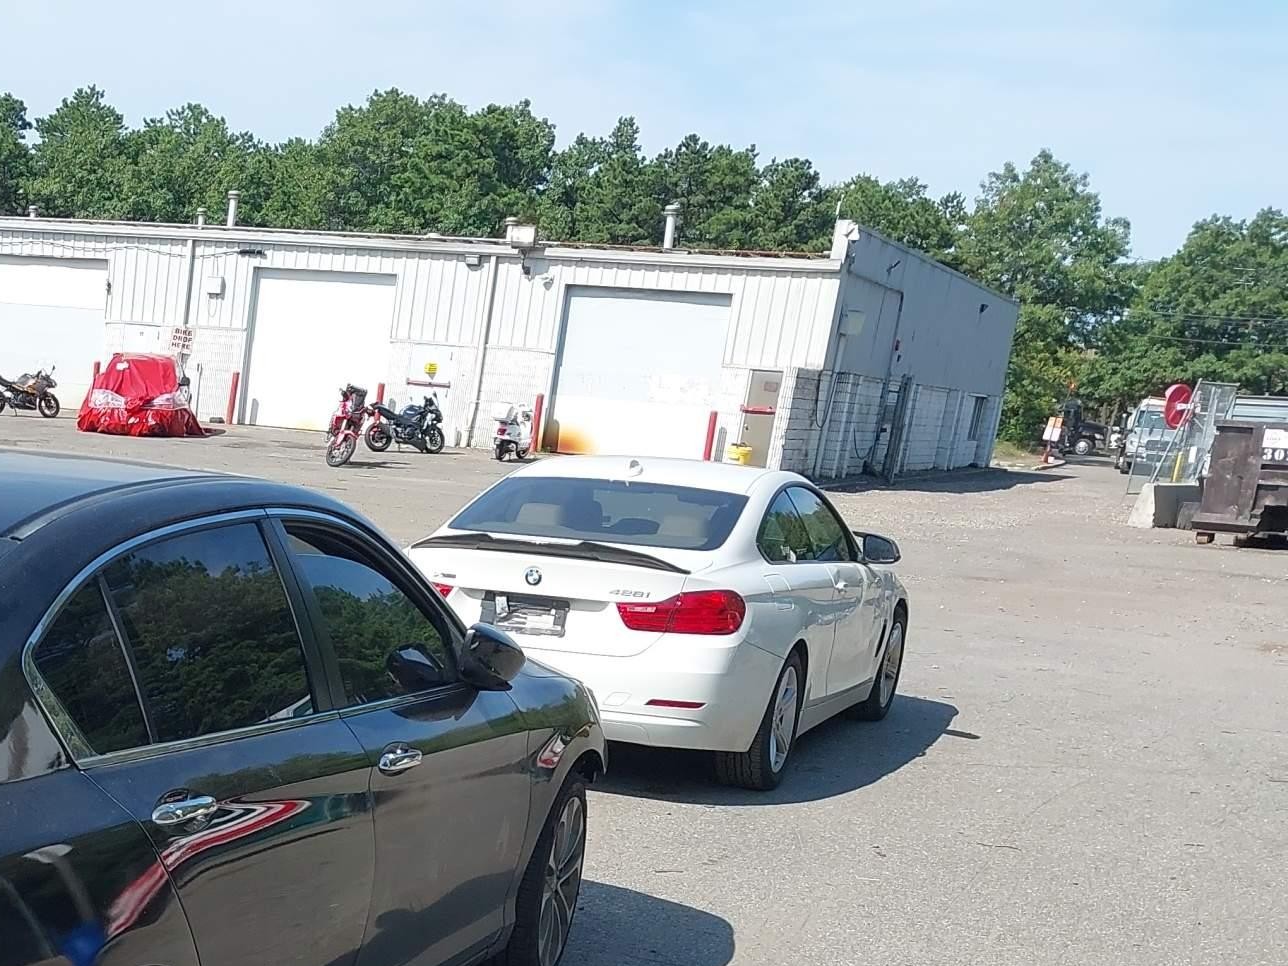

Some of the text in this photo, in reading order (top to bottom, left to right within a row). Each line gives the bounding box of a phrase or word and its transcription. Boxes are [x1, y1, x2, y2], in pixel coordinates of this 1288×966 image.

[174, 328, 193, 337] BIKE
[172, 335, 193, 344] DROP
[171, 342, 191, 350] HERE
[1262, 448, 1288, 461] 30
